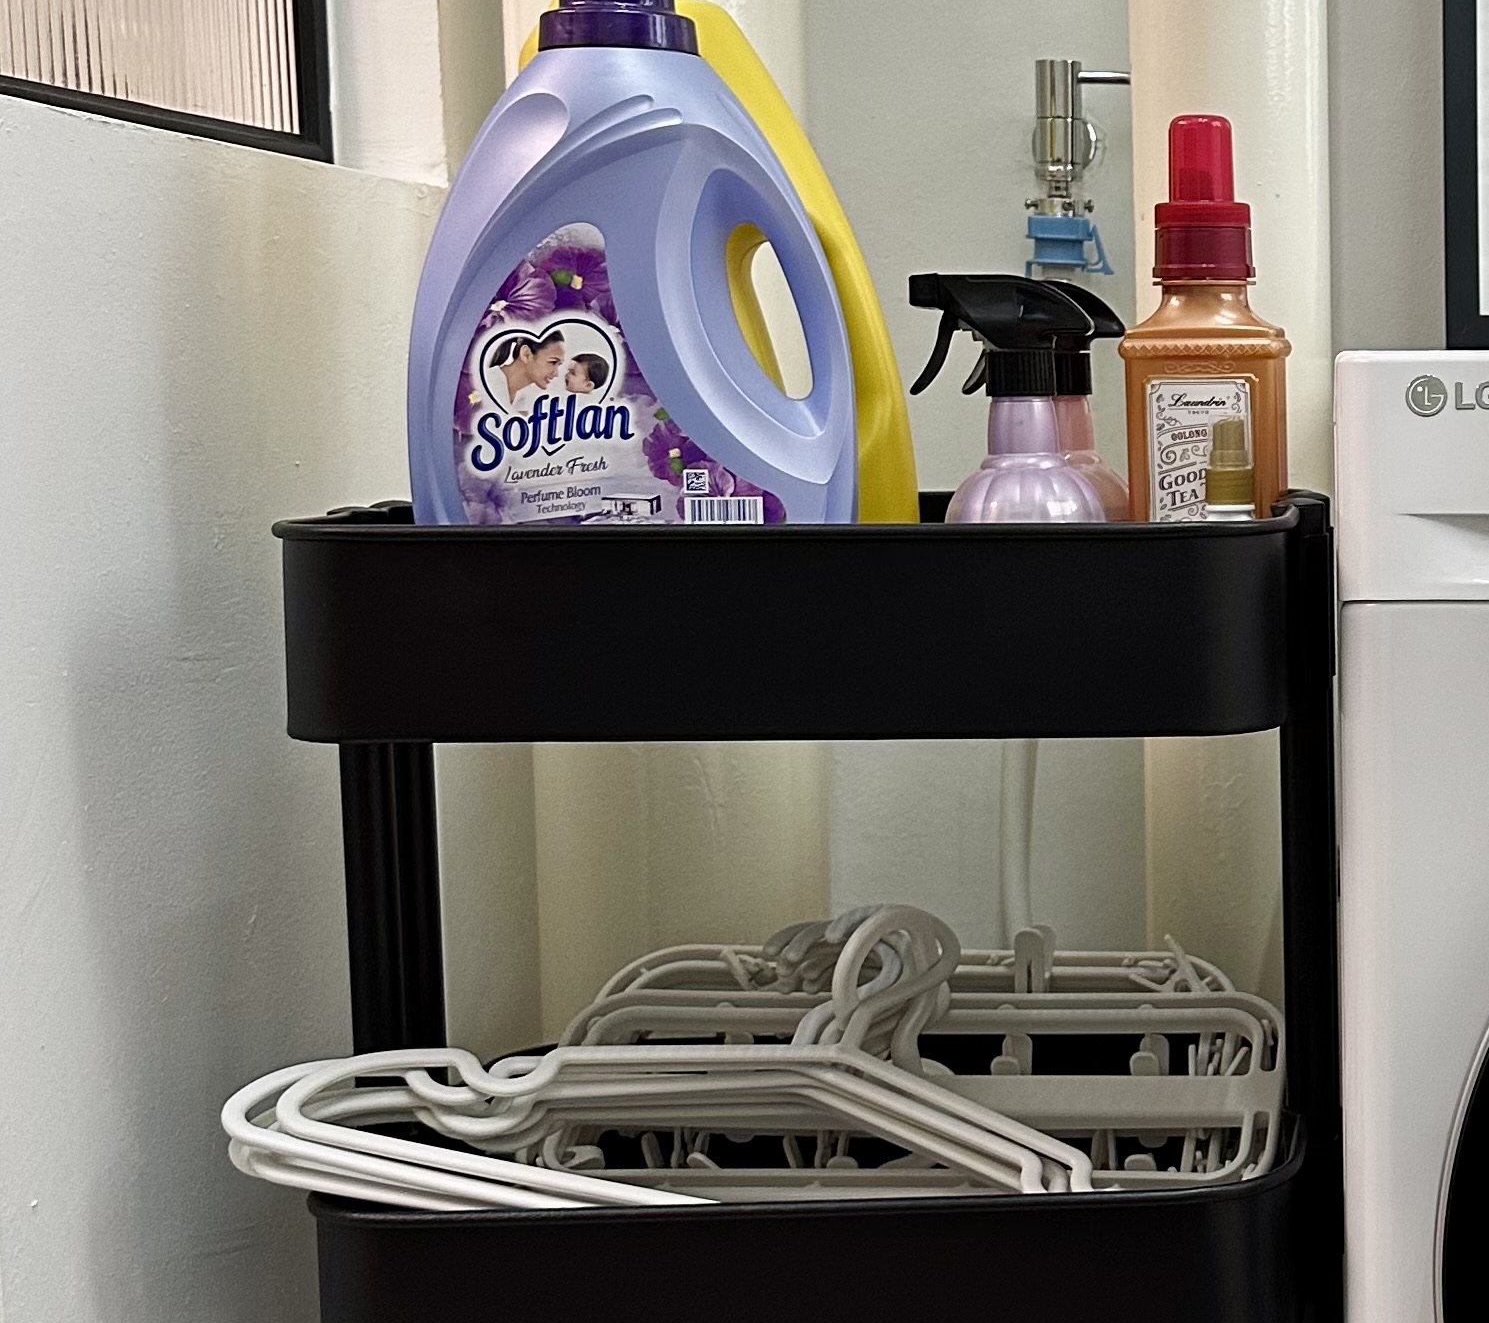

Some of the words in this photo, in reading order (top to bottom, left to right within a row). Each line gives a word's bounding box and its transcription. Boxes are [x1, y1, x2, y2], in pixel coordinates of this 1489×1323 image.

[1168, 393, 1227, 408] Laundrin
[470, 394, 635, 473] Softlan
[504, 464, 564, 484] Lavender
[567, 455, 609, 476] Fresh
[1158, 468, 1207, 491] GOOD
[520, 486, 565, 505] Perfume
[566, 484, 602, 498] Bloom
[1166, 487, 1199, 507] TEA
[535, 500, 587, 515] Technology
